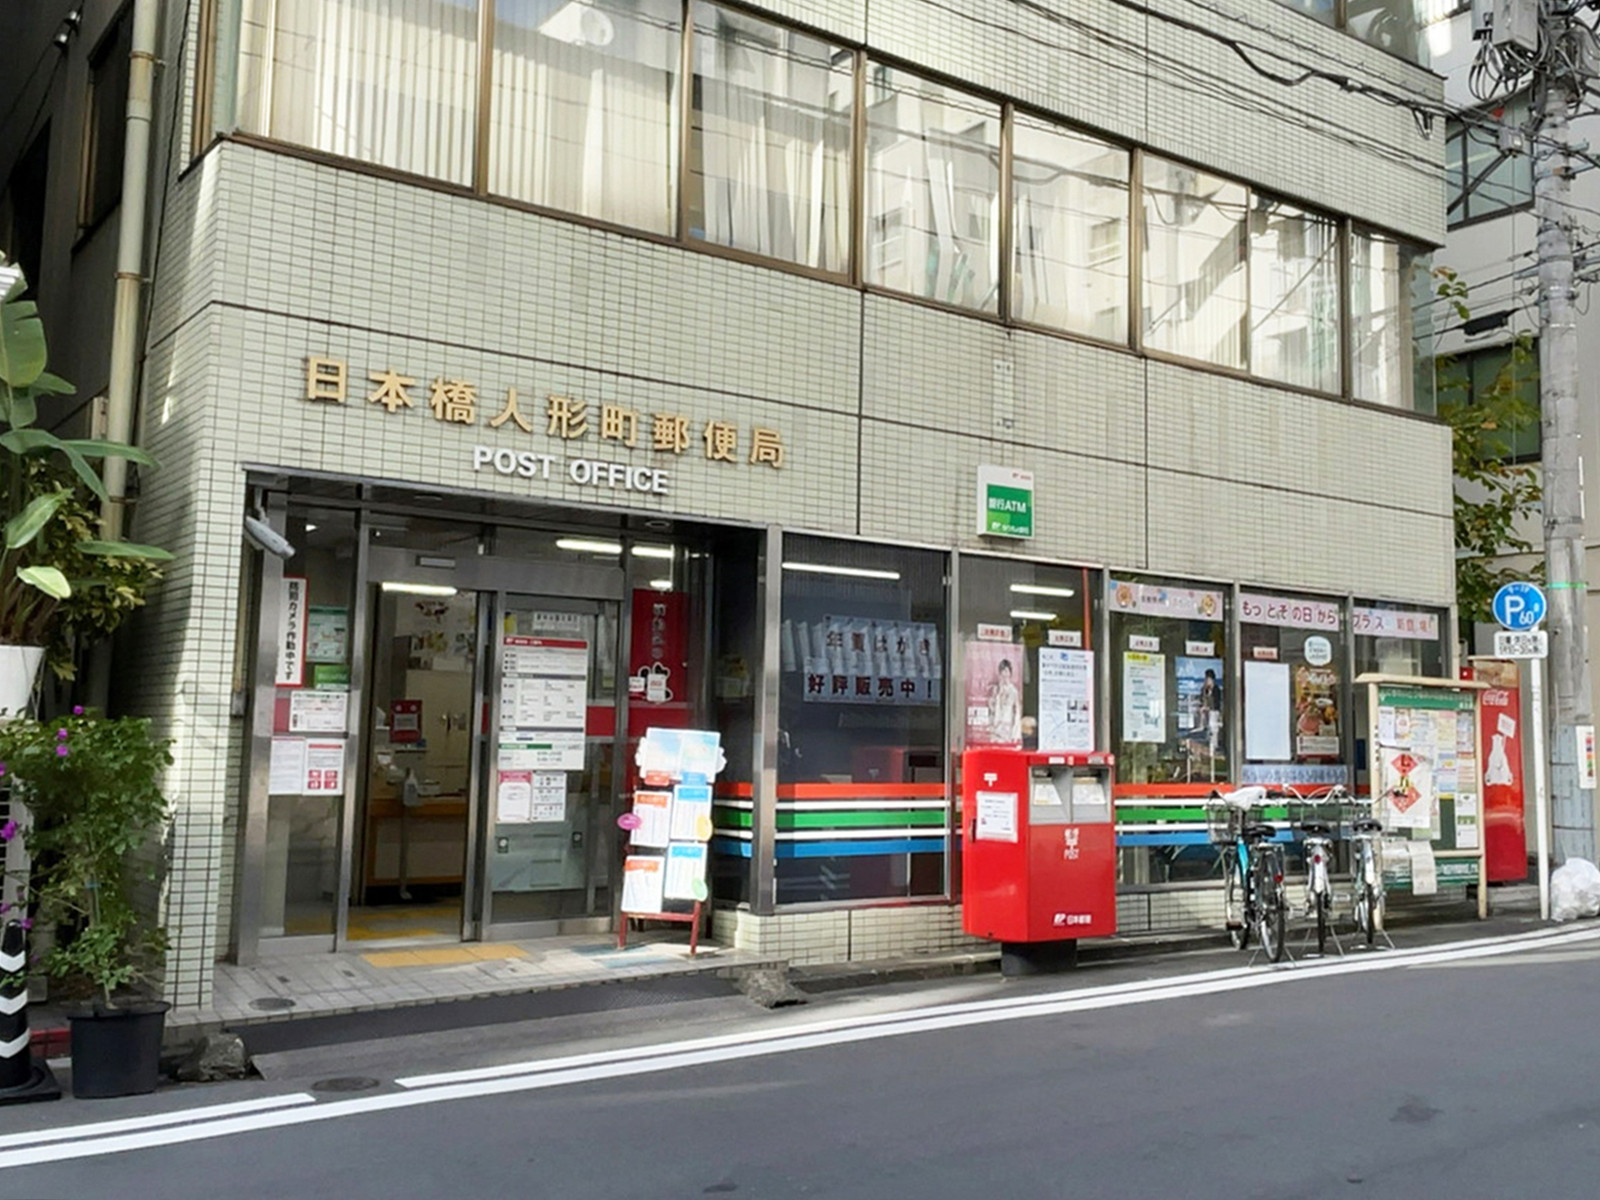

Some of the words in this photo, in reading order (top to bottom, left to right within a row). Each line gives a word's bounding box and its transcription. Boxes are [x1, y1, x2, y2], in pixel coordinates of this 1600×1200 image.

[304, 355, 787, 469] 日本橋人形町郵便局
[473, 445, 556, 480] POST
[569, 458, 669, 495] OFFICE
[1241, 600, 1337, 625] もっとその日から
[1504, 595, 1525, 625] P
[1519, 611, 1534, 625] 60
